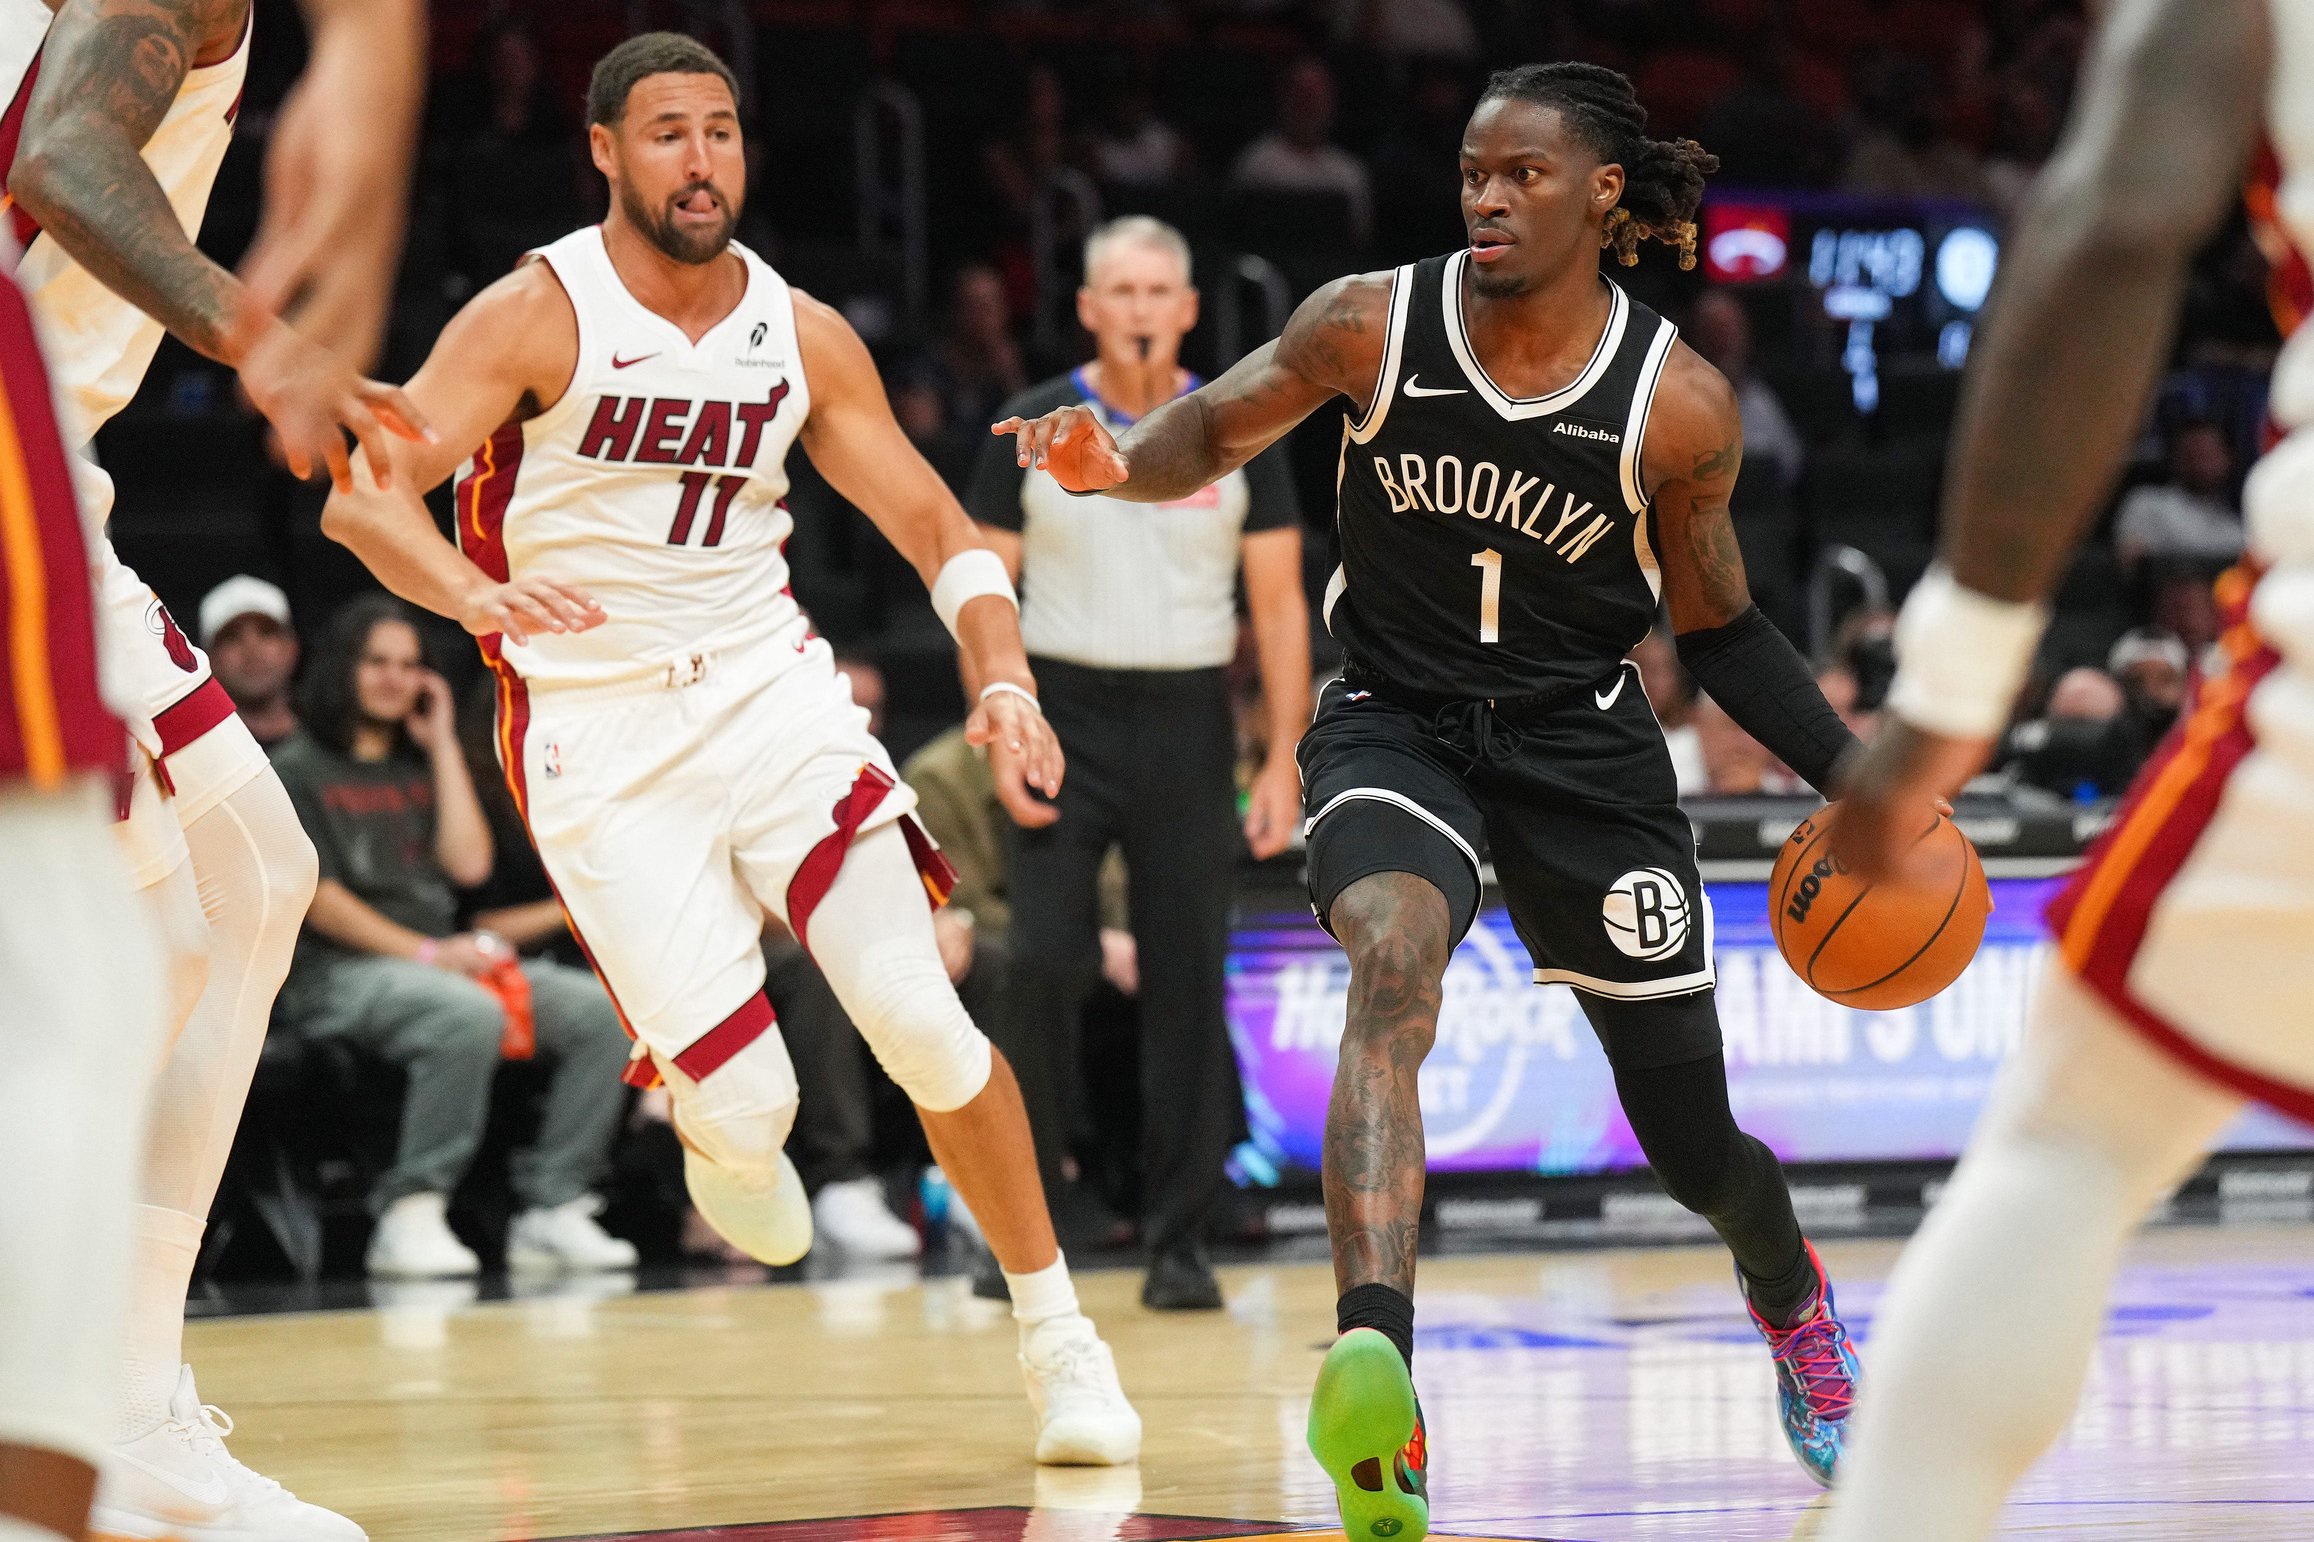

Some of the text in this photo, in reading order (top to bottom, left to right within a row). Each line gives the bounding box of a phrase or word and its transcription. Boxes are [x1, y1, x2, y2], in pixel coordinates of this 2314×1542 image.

[734, 357, 785, 369] Robinhood
[577, 377, 789, 469] HEAT
[1553, 422, 1620, 444] Alibaba
[667, 471, 749, 547] 11
[1374, 453, 1615, 565] BROOKLYN
[1471, 547, 1502, 643] 1
[1632, 880, 1669, 949] B
